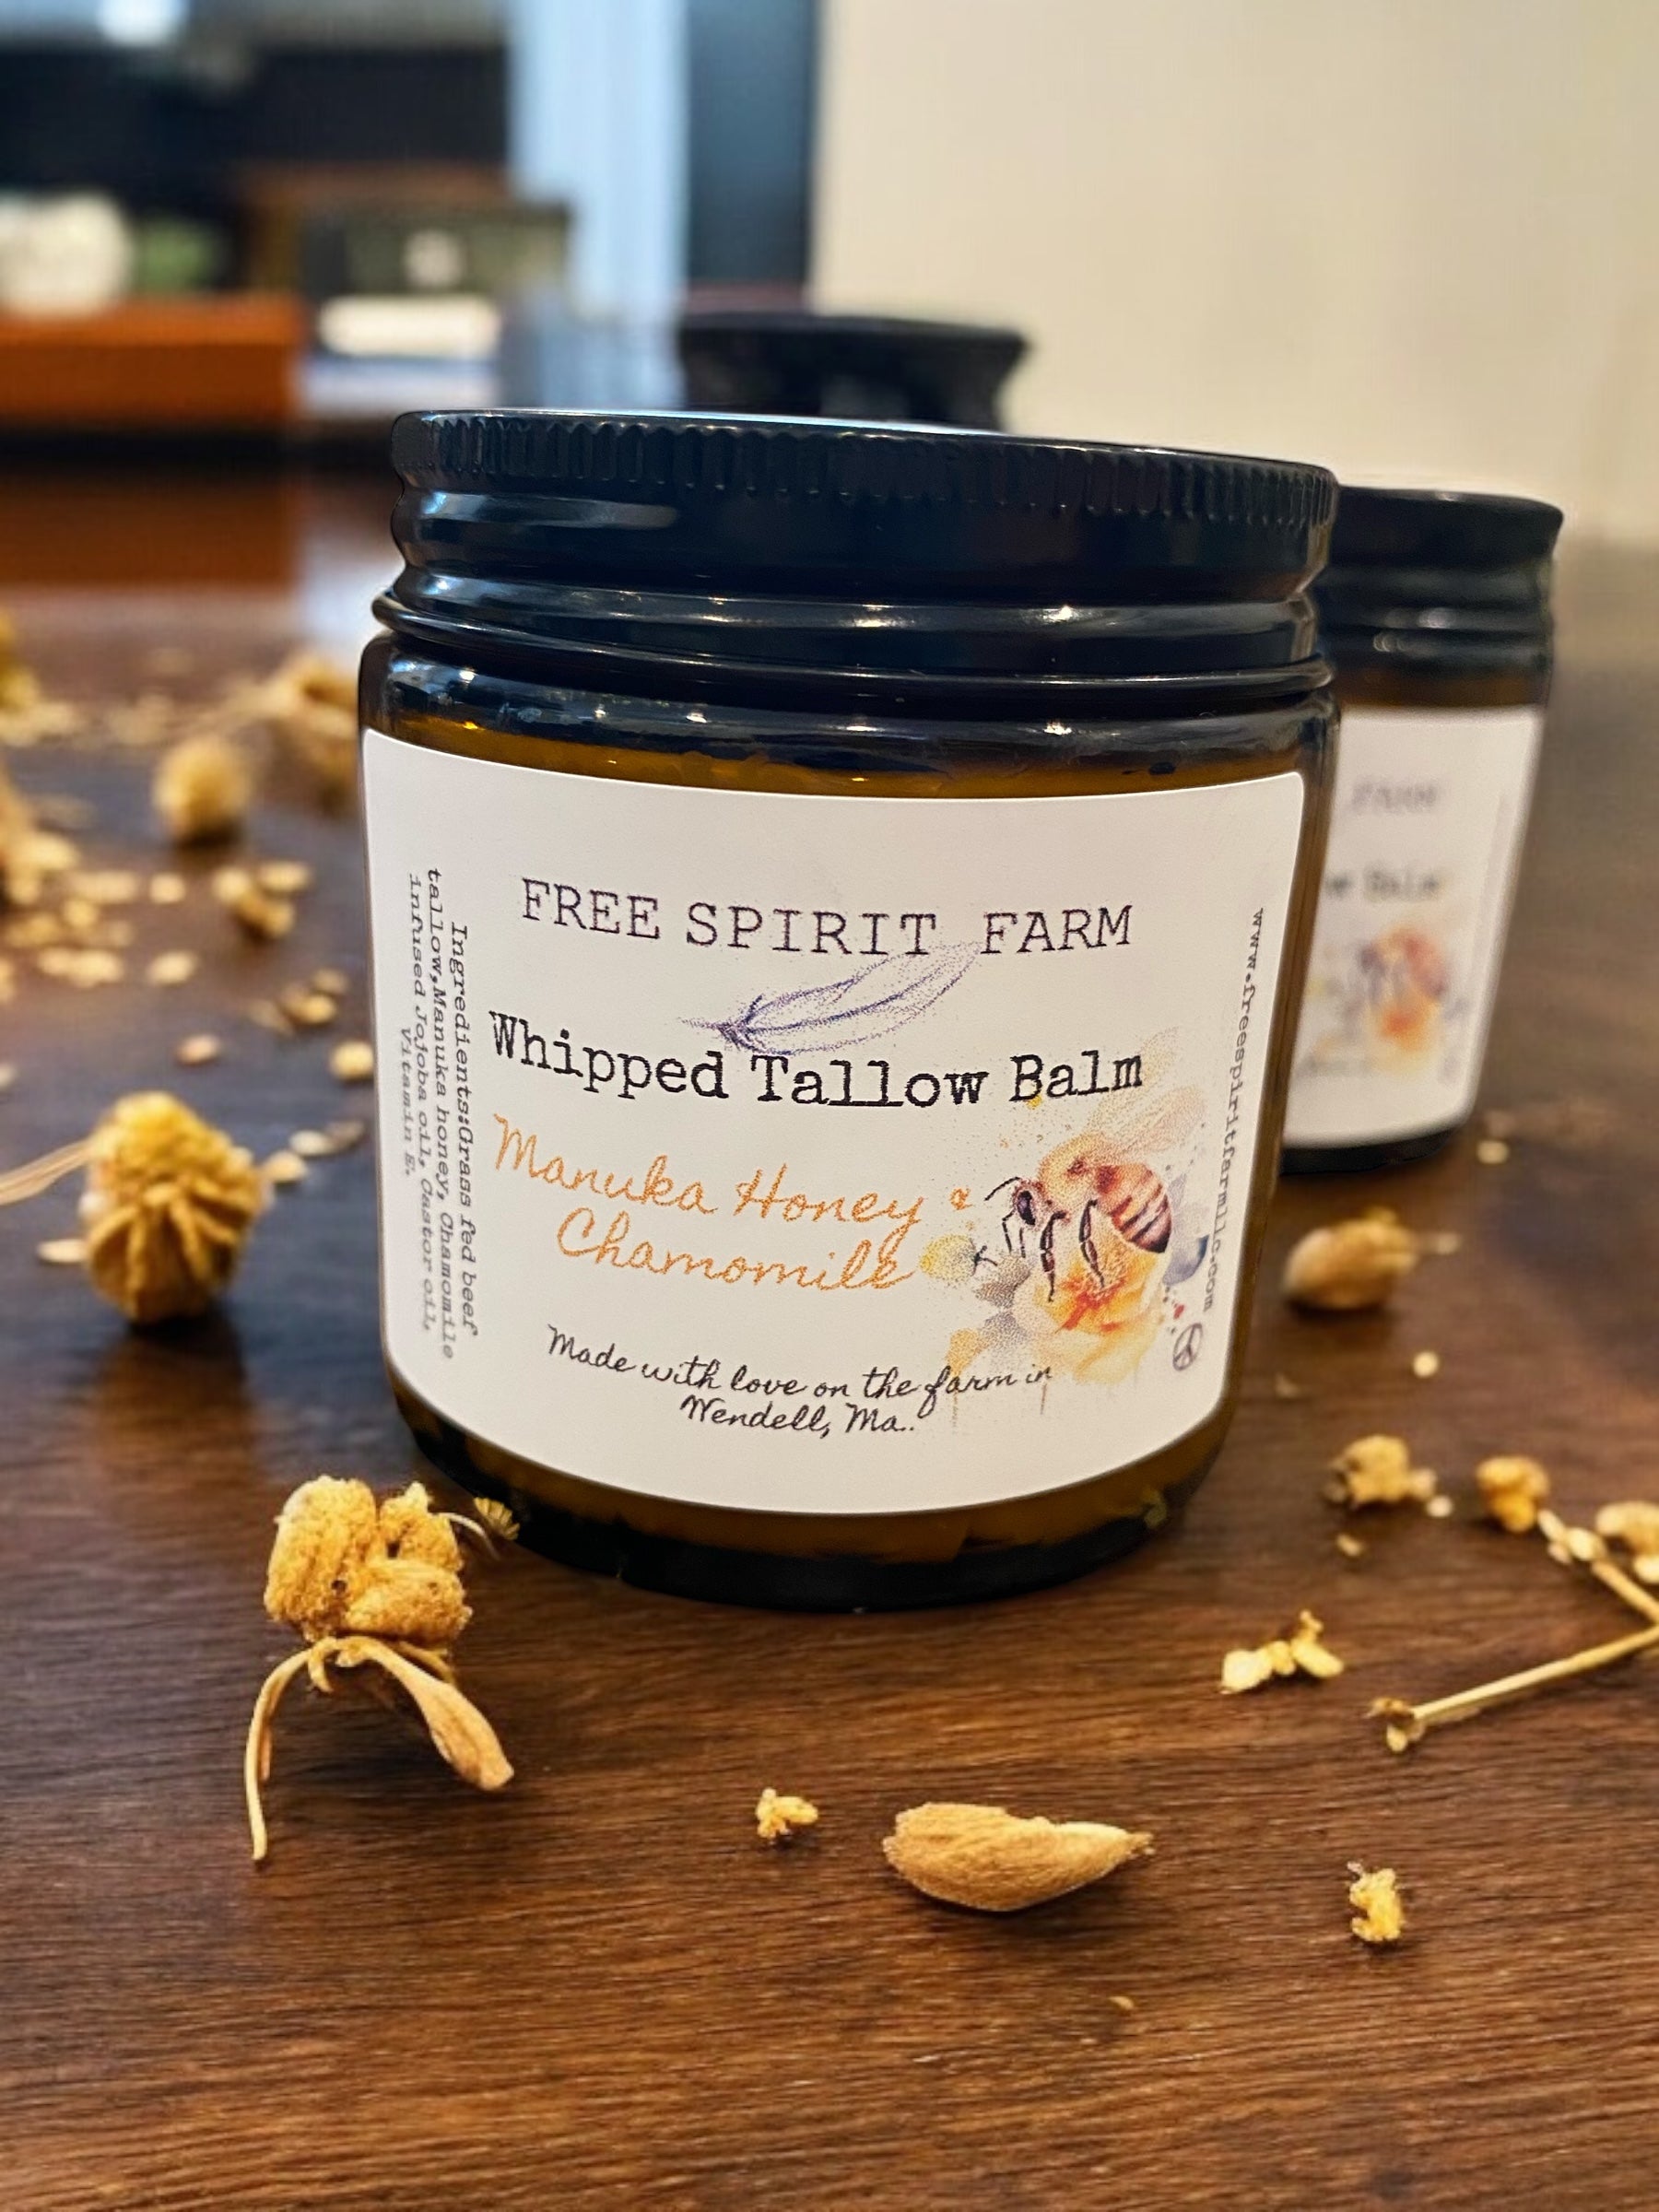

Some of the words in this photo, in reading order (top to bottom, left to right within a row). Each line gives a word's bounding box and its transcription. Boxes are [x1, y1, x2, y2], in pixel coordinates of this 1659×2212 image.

[409, 873, 426, 997] infused
[522, 877, 661, 939] FREE
[686, 901, 937, 956] SPIRIT
[980, 904, 1133, 955] FARM
[401, 1029, 414, 1142] Vitamin
[414, 1005, 429, 1101] Jojoba
[488, 1010, 730, 1100] Whipped
[750, 1053, 990, 1108] Tallow
[1008, 1049, 1143, 1102] Balm
[418, 1111, 431, 1168] oil,
[435, 1105, 450, 1200] honey,
[1203, 907, 1264, 1312] www.freespiritfarmllc.com
[420, 1178, 433, 1273] Castor
[493, 1112, 718, 1215] Manuka
[734, 1162, 924, 1264] Honey
[439, 1212, 456, 1359] Chamomile
[461, 1214, 477, 1263] fed
[557, 1206, 915, 1291] Chamomile
[462, 1271, 478, 1336] beef
[547, 1324, 636, 1372] Made
[641, 1355, 722, 1389] with
[730, 1364, 808, 1396] love
[813, 1382, 851, 1397] on
[862, 1366, 919, 1399] the
[916, 1365, 1018, 1419] farm
[1025, 1363, 1053, 1383] in
[678, 1394, 831, 1440] Wendell,
